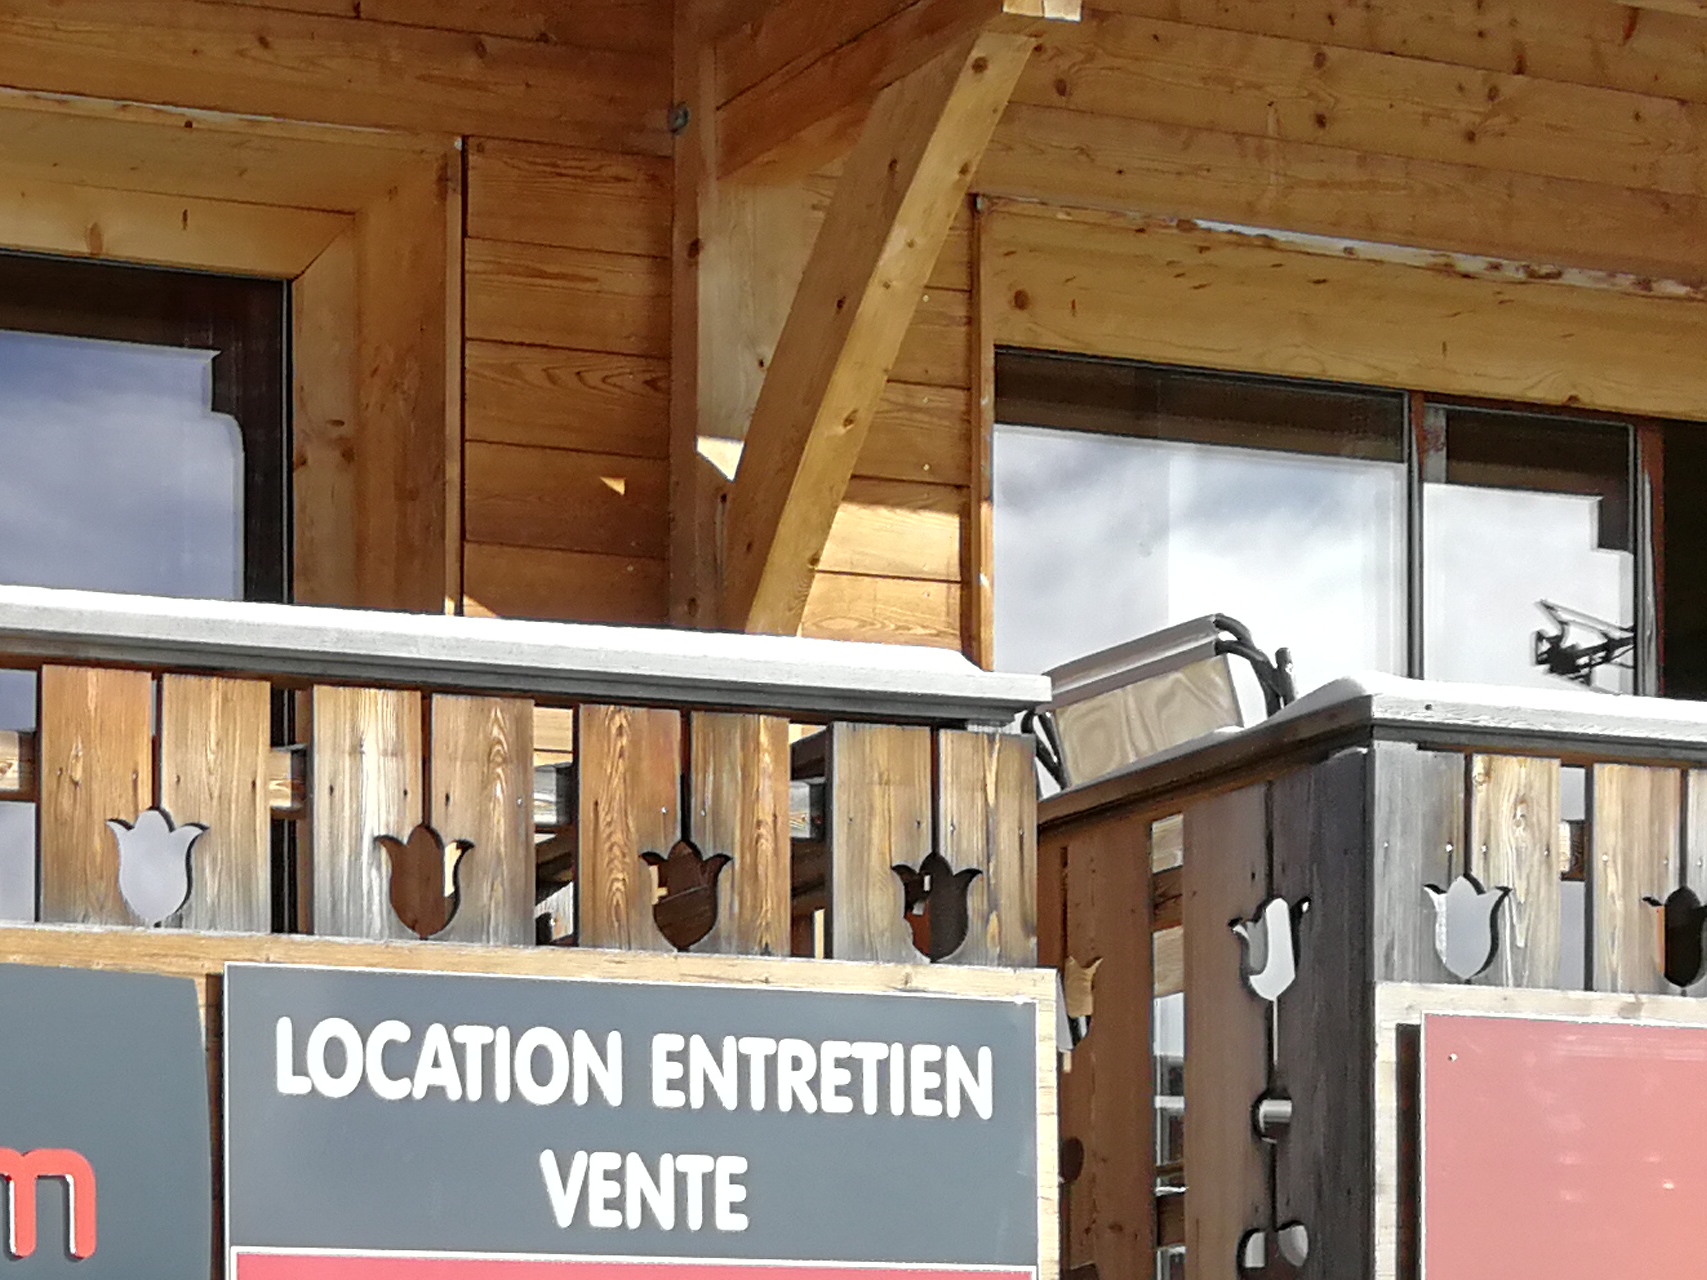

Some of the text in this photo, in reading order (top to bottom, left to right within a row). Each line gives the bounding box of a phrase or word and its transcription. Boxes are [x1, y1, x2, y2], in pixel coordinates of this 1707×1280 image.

[275, 1015, 994, 1120] LOCATION ENTRETIEN
[539, 1148, 750, 1232] VENTE
